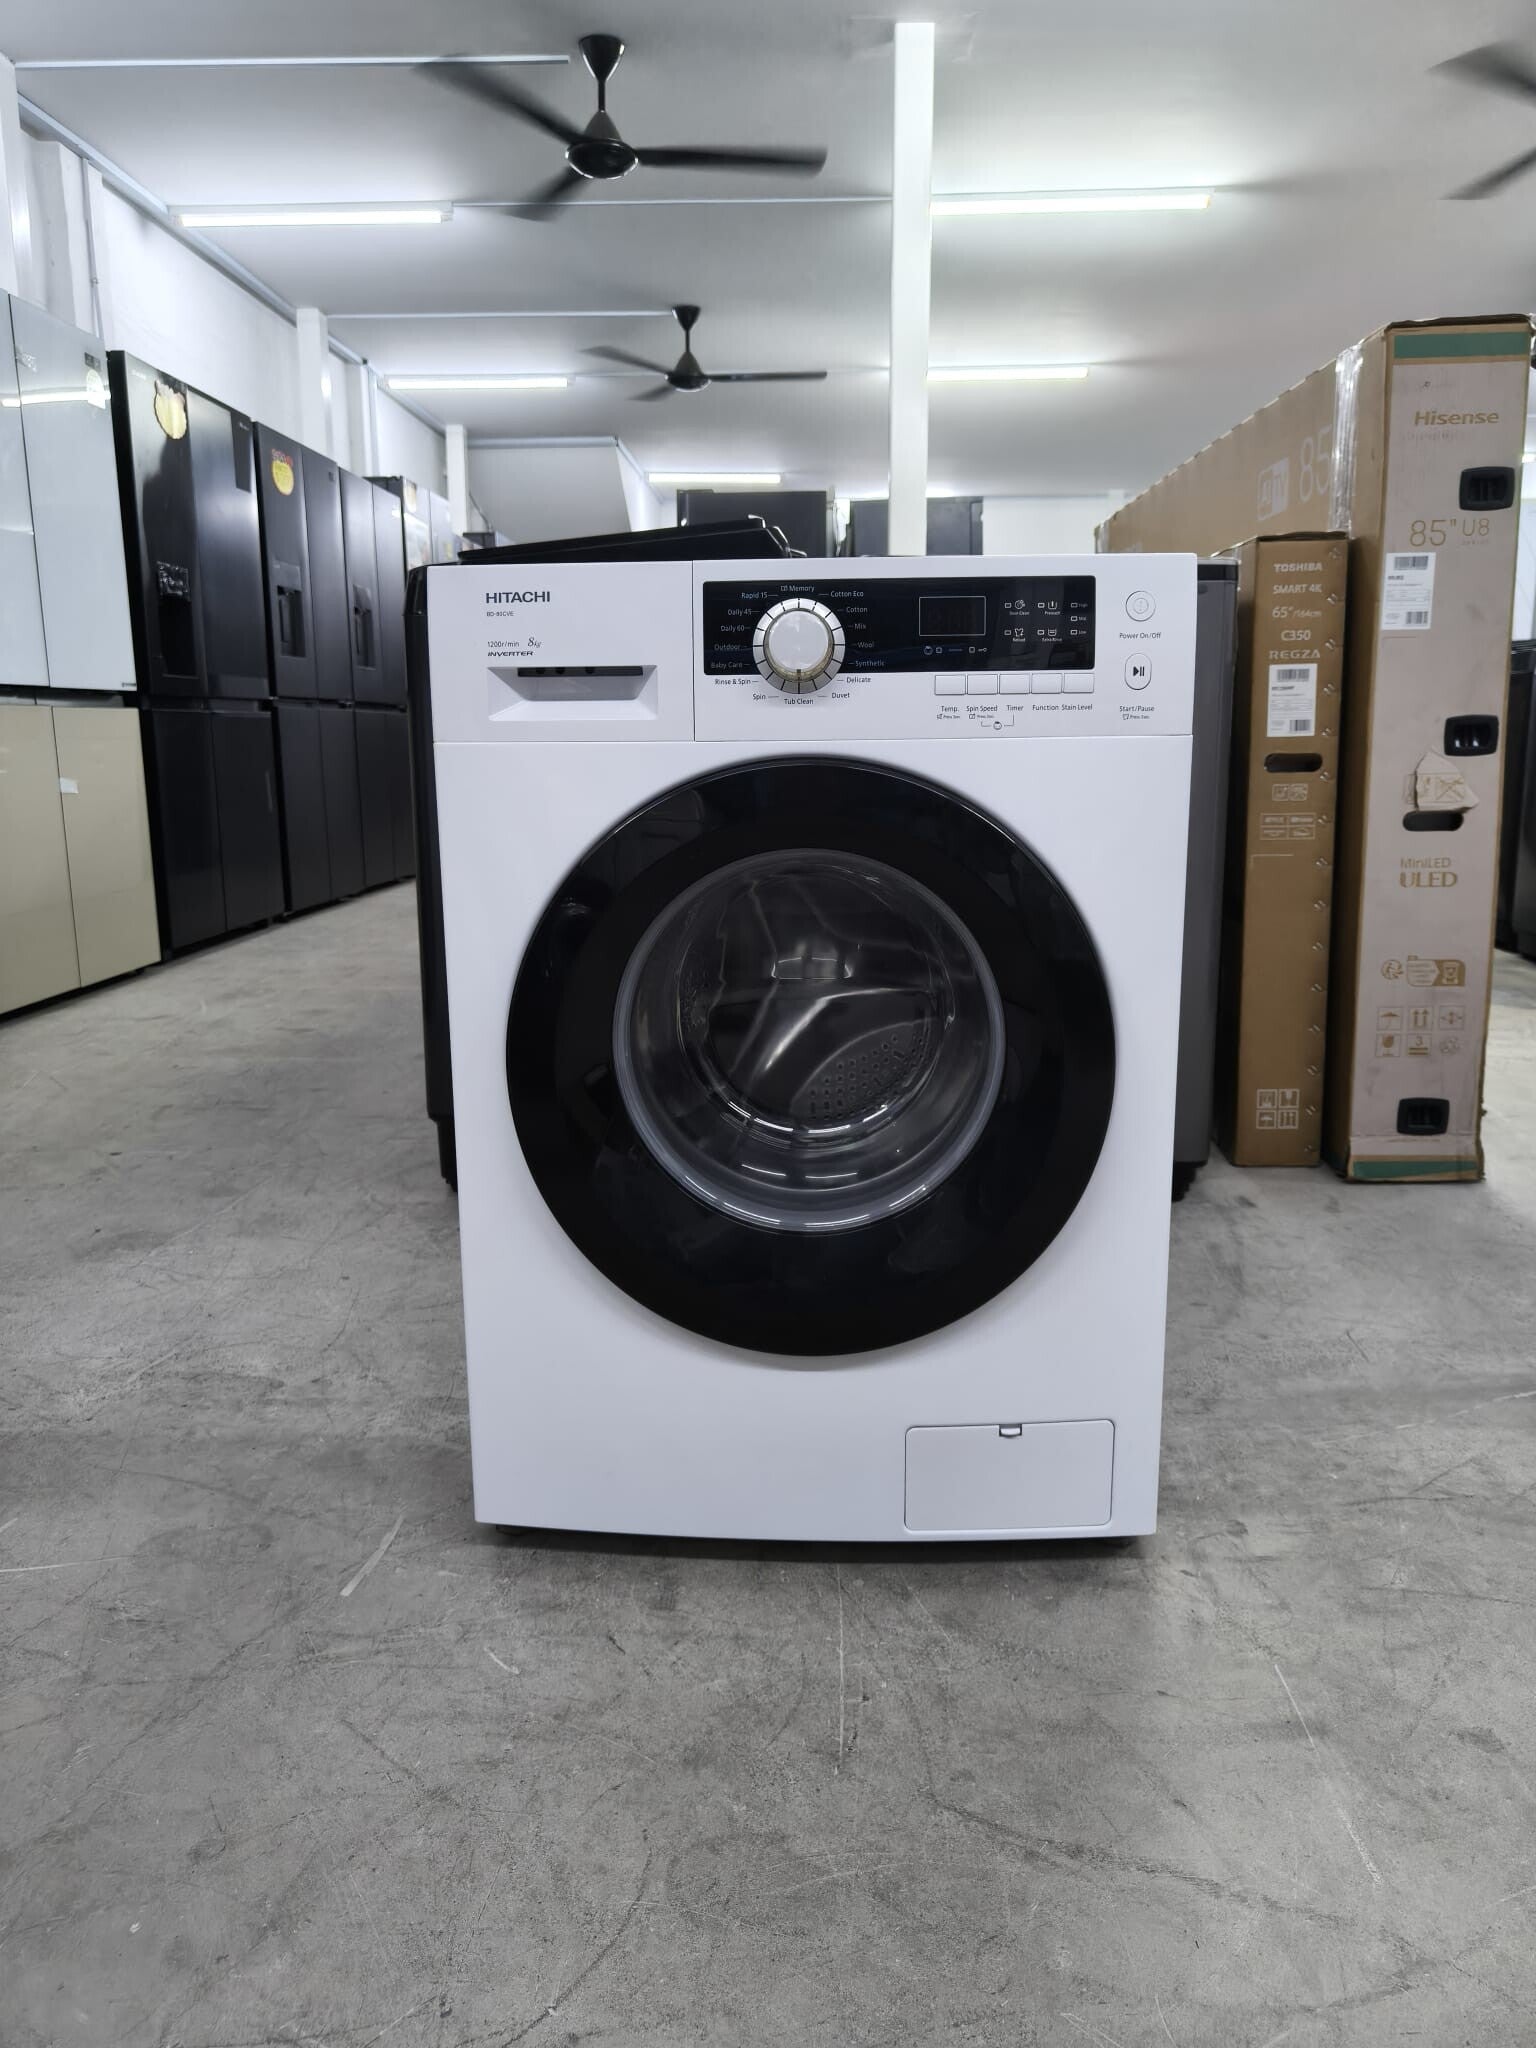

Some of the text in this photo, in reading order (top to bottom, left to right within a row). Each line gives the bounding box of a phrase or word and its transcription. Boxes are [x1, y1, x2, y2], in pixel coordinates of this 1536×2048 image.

[1414, 410, 1500, 427] Hisense
[1463, 517, 1490, 537] U8
[1273, 562, 1322, 572] TOSHIBA
[789, 585, 815, 593] Memory
[1273, 583, 1322, 594] SMART 4K
[486, 591, 550, 603] HITACHI
[830, 590, 852, 598] Cotton
[727, 609, 743, 617] Daily
[1281, 630, 1311, 640] C350
[487, 640, 520, 648] 1200r/min
[1269, 649, 1321, 659] REGZA
[738, 678, 751, 686] Spin
[1399, 871, 1458, 888] ULED
